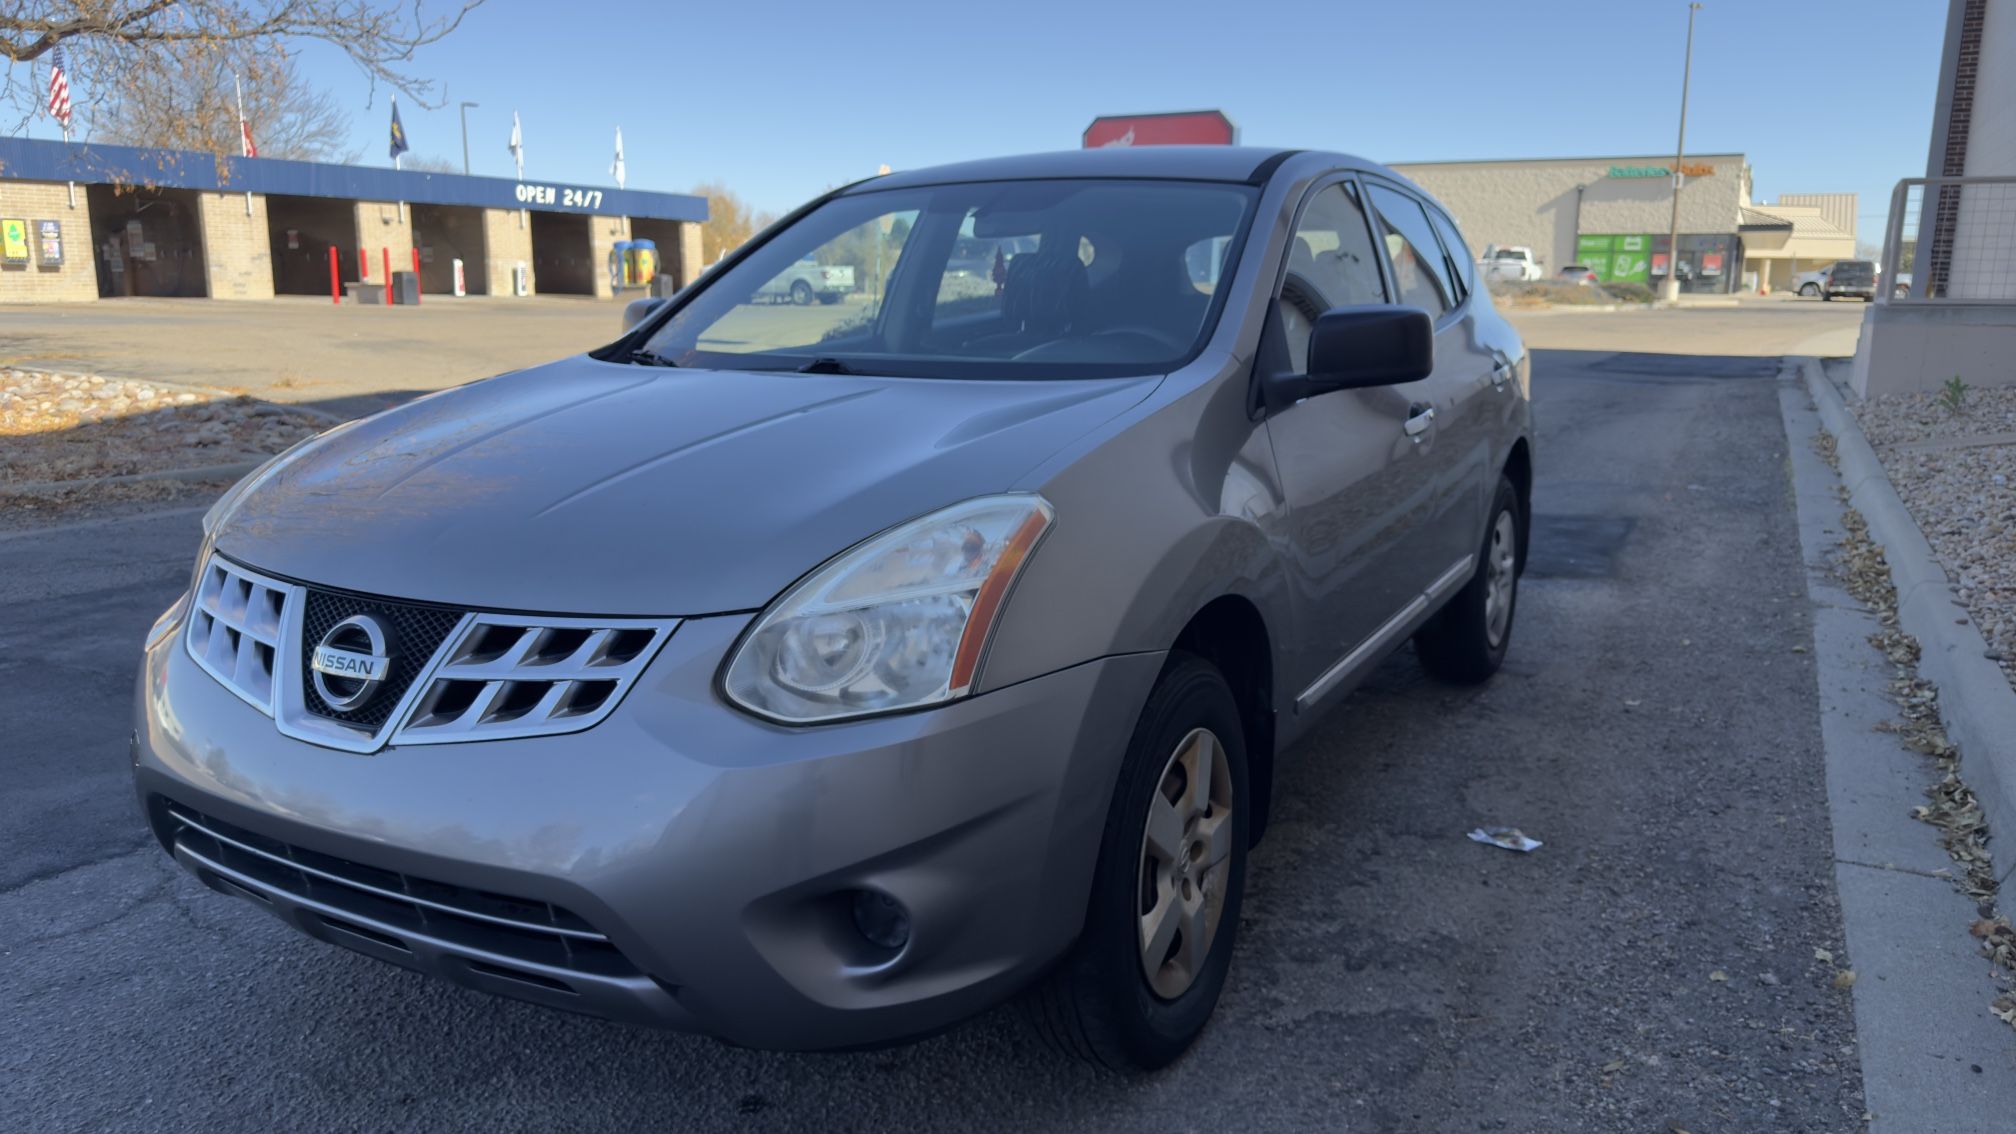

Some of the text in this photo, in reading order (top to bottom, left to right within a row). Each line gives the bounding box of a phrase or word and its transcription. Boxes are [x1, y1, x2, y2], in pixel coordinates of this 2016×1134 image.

[515, 184, 603, 209] OPEN 24/7
[314, 651, 374, 675] NISSAN
